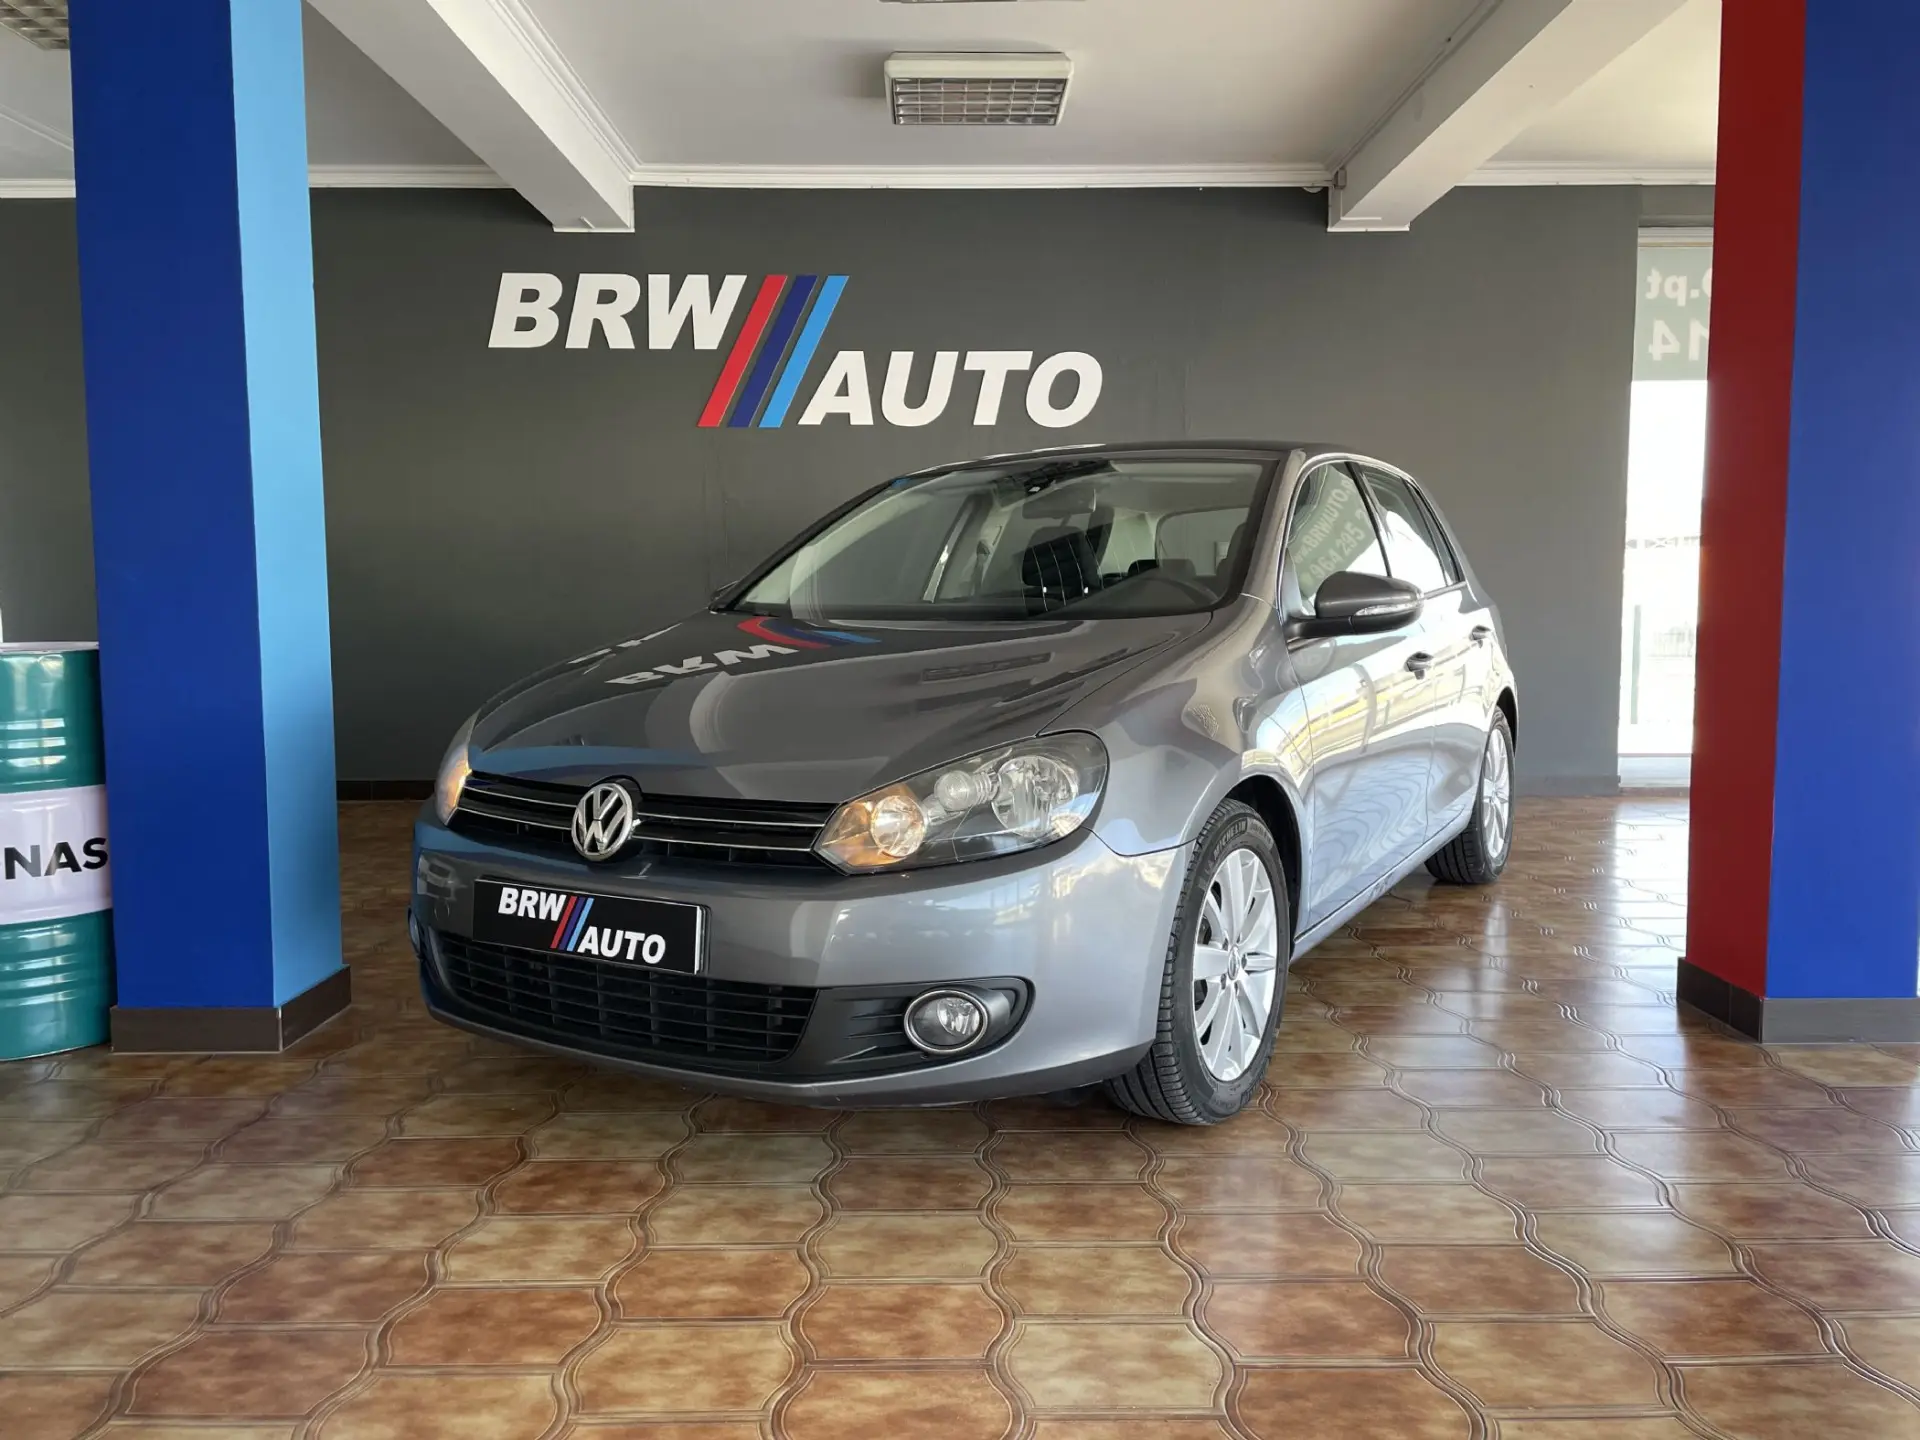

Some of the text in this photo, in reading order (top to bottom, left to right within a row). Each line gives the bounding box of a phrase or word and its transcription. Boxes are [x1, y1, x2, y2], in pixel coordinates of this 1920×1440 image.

[487, 272, 748, 350] BRW
[797, 350, 1104, 428] AUTO
[498, 886, 567, 922] BRW
[577, 926, 666, 965] AUTO
